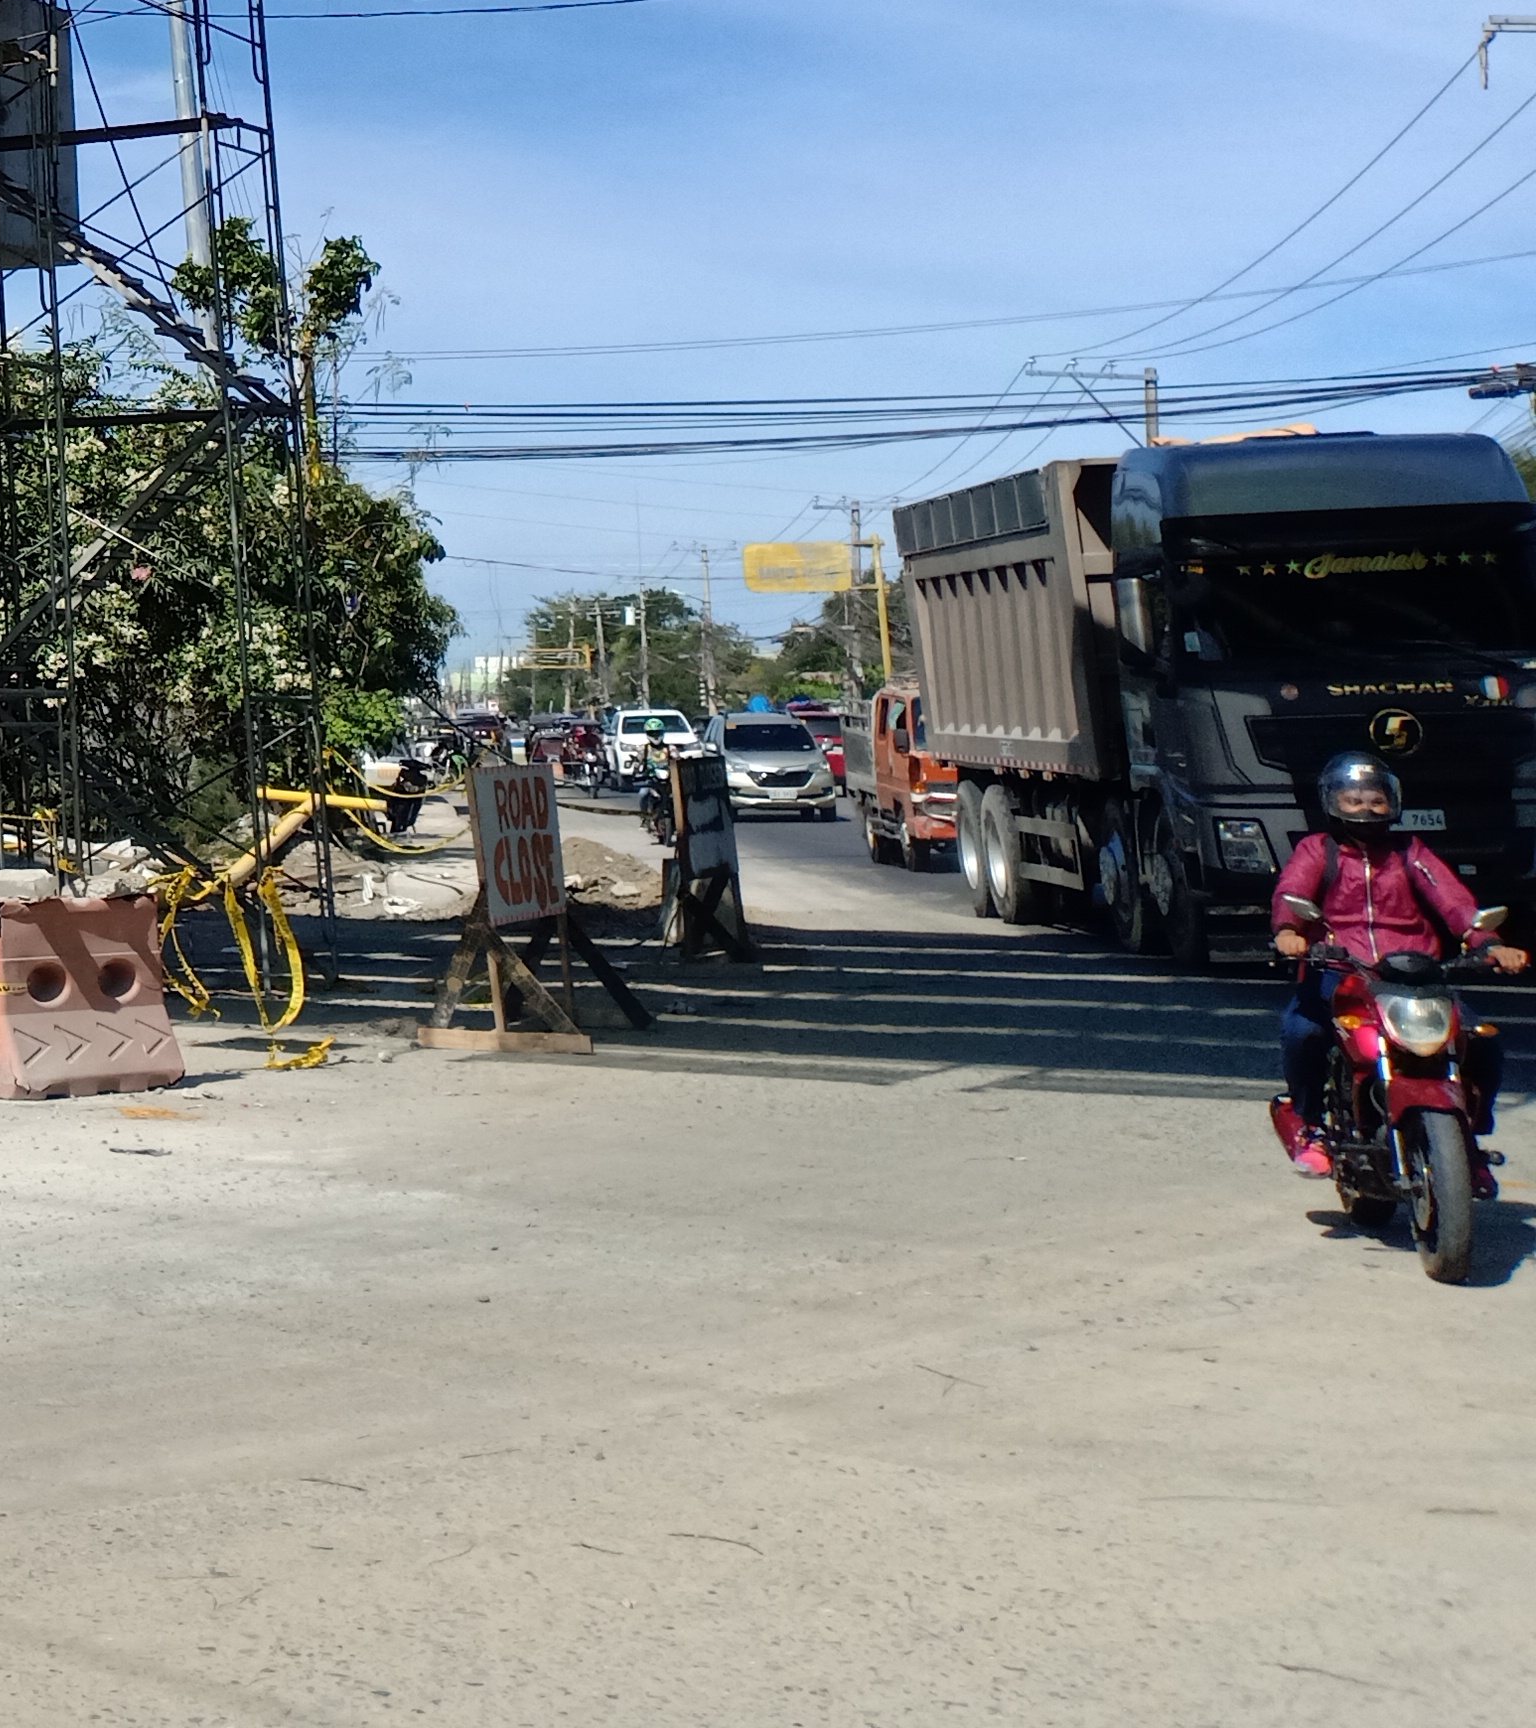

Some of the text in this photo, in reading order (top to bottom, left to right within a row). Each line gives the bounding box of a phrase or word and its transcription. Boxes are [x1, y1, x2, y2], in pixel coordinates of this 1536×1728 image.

[1327, 681, 1454, 696] SHACMAN
[493, 776, 549, 833] ROAD
[493, 832, 560, 912] CLOSE
